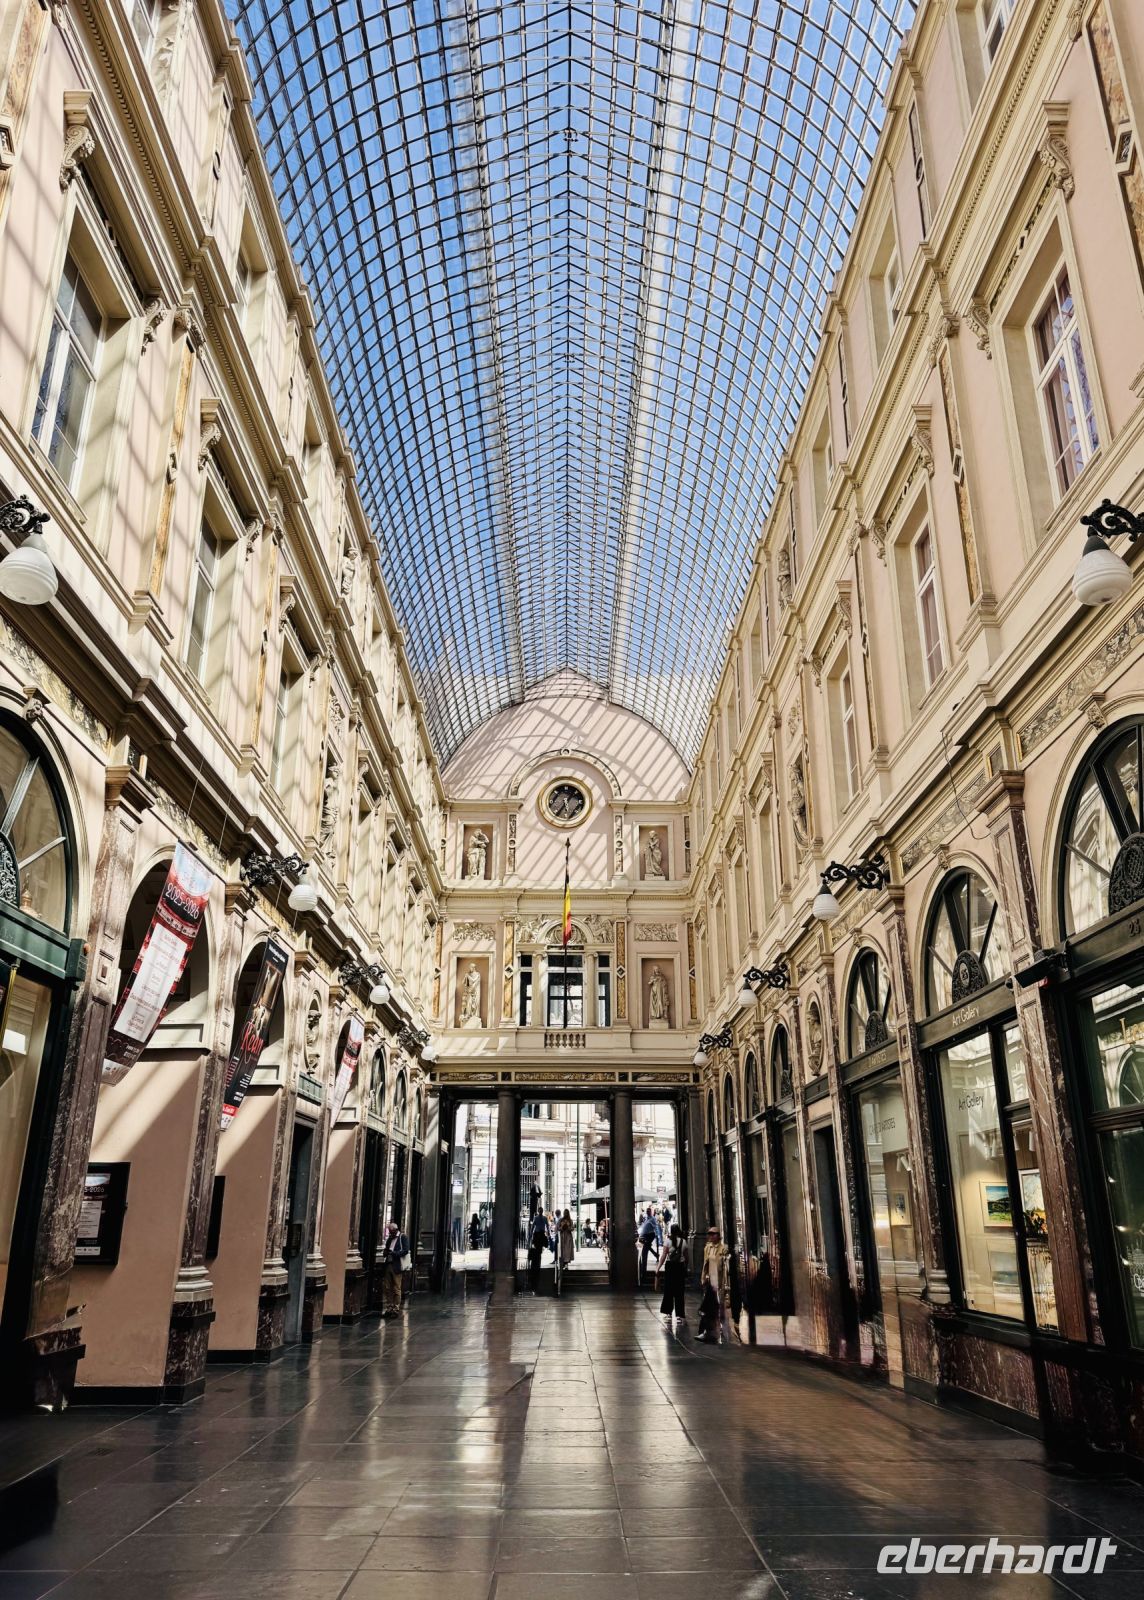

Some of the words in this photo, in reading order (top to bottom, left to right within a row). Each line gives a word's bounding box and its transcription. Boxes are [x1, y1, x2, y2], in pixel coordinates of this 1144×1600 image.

[165, 882, 200, 919] 2025-2026
[952, 1013, 961, 1027] Art
[960, 1005, 980, 1022] Gallery
[958, 1097, 966, 1112] Art
[966, 1091, 984, 1110] Gallery
